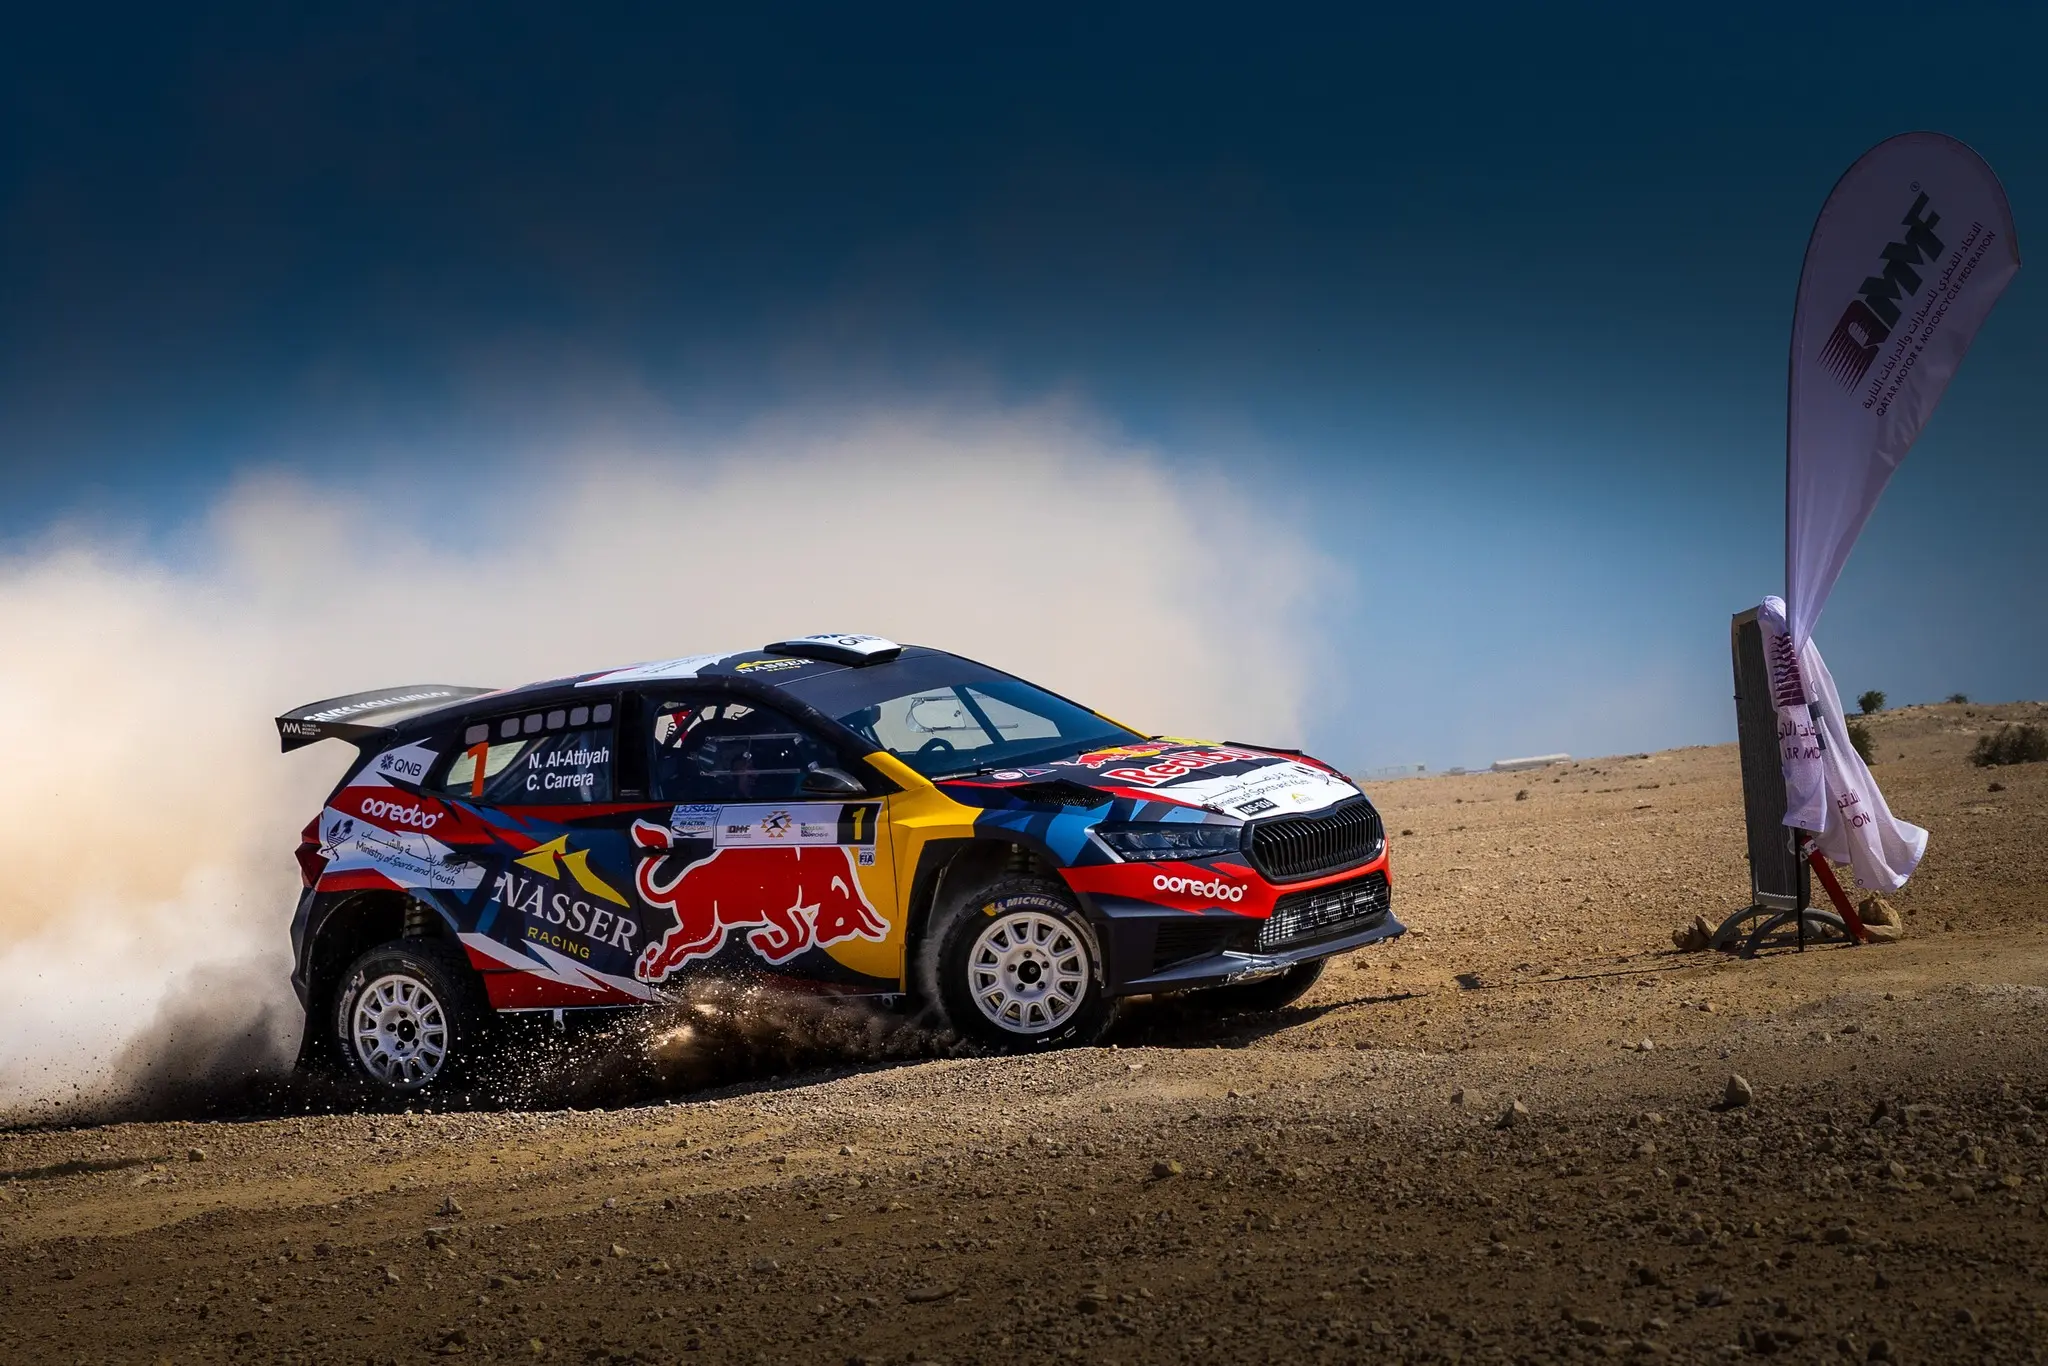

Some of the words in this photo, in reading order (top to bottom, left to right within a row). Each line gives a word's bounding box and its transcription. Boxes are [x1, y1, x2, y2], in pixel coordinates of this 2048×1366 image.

[1957, 230, 1996, 284] FEDERATION
[1817, 191, 1945, 397] QMMF
[1919, 282, 1962, 344] MOTORCYCLE
[1916, 344, 1924, 353] &
[1896, 350, 1919, 386] MOTOR
[1875, 385, 1899, 417] QATAR
[737, 659, 814, 674] NASSER
[394, 758, 422, 777] QNB
[467, 741, 489, 798] 1
[528, 752, 543, 769] N.
[546, 746, 610, 769] Al-Attiyah
[1100, 755, 1207, 787] Red
[526, 774, 540, 791] C.
[544, 772, 594, 790] Carrera
[360, 797, 442, 829] ooredoo
[852, 806, 867, 841] 1
[356, 840, 384, 863] Ministry
[391, 856, 414, 871] Sports
[413, 865, 430, 877] and
[431, 868, 456, 887] Youth
[860, 854, 874, 864] FIA
[1006, 896, 1068, 912] MICHELIN
[1153, 875, 1245, 902] ooredoo
[491, 871, 638, 953] NASSER
[527, 926, 591, 959] RACING
